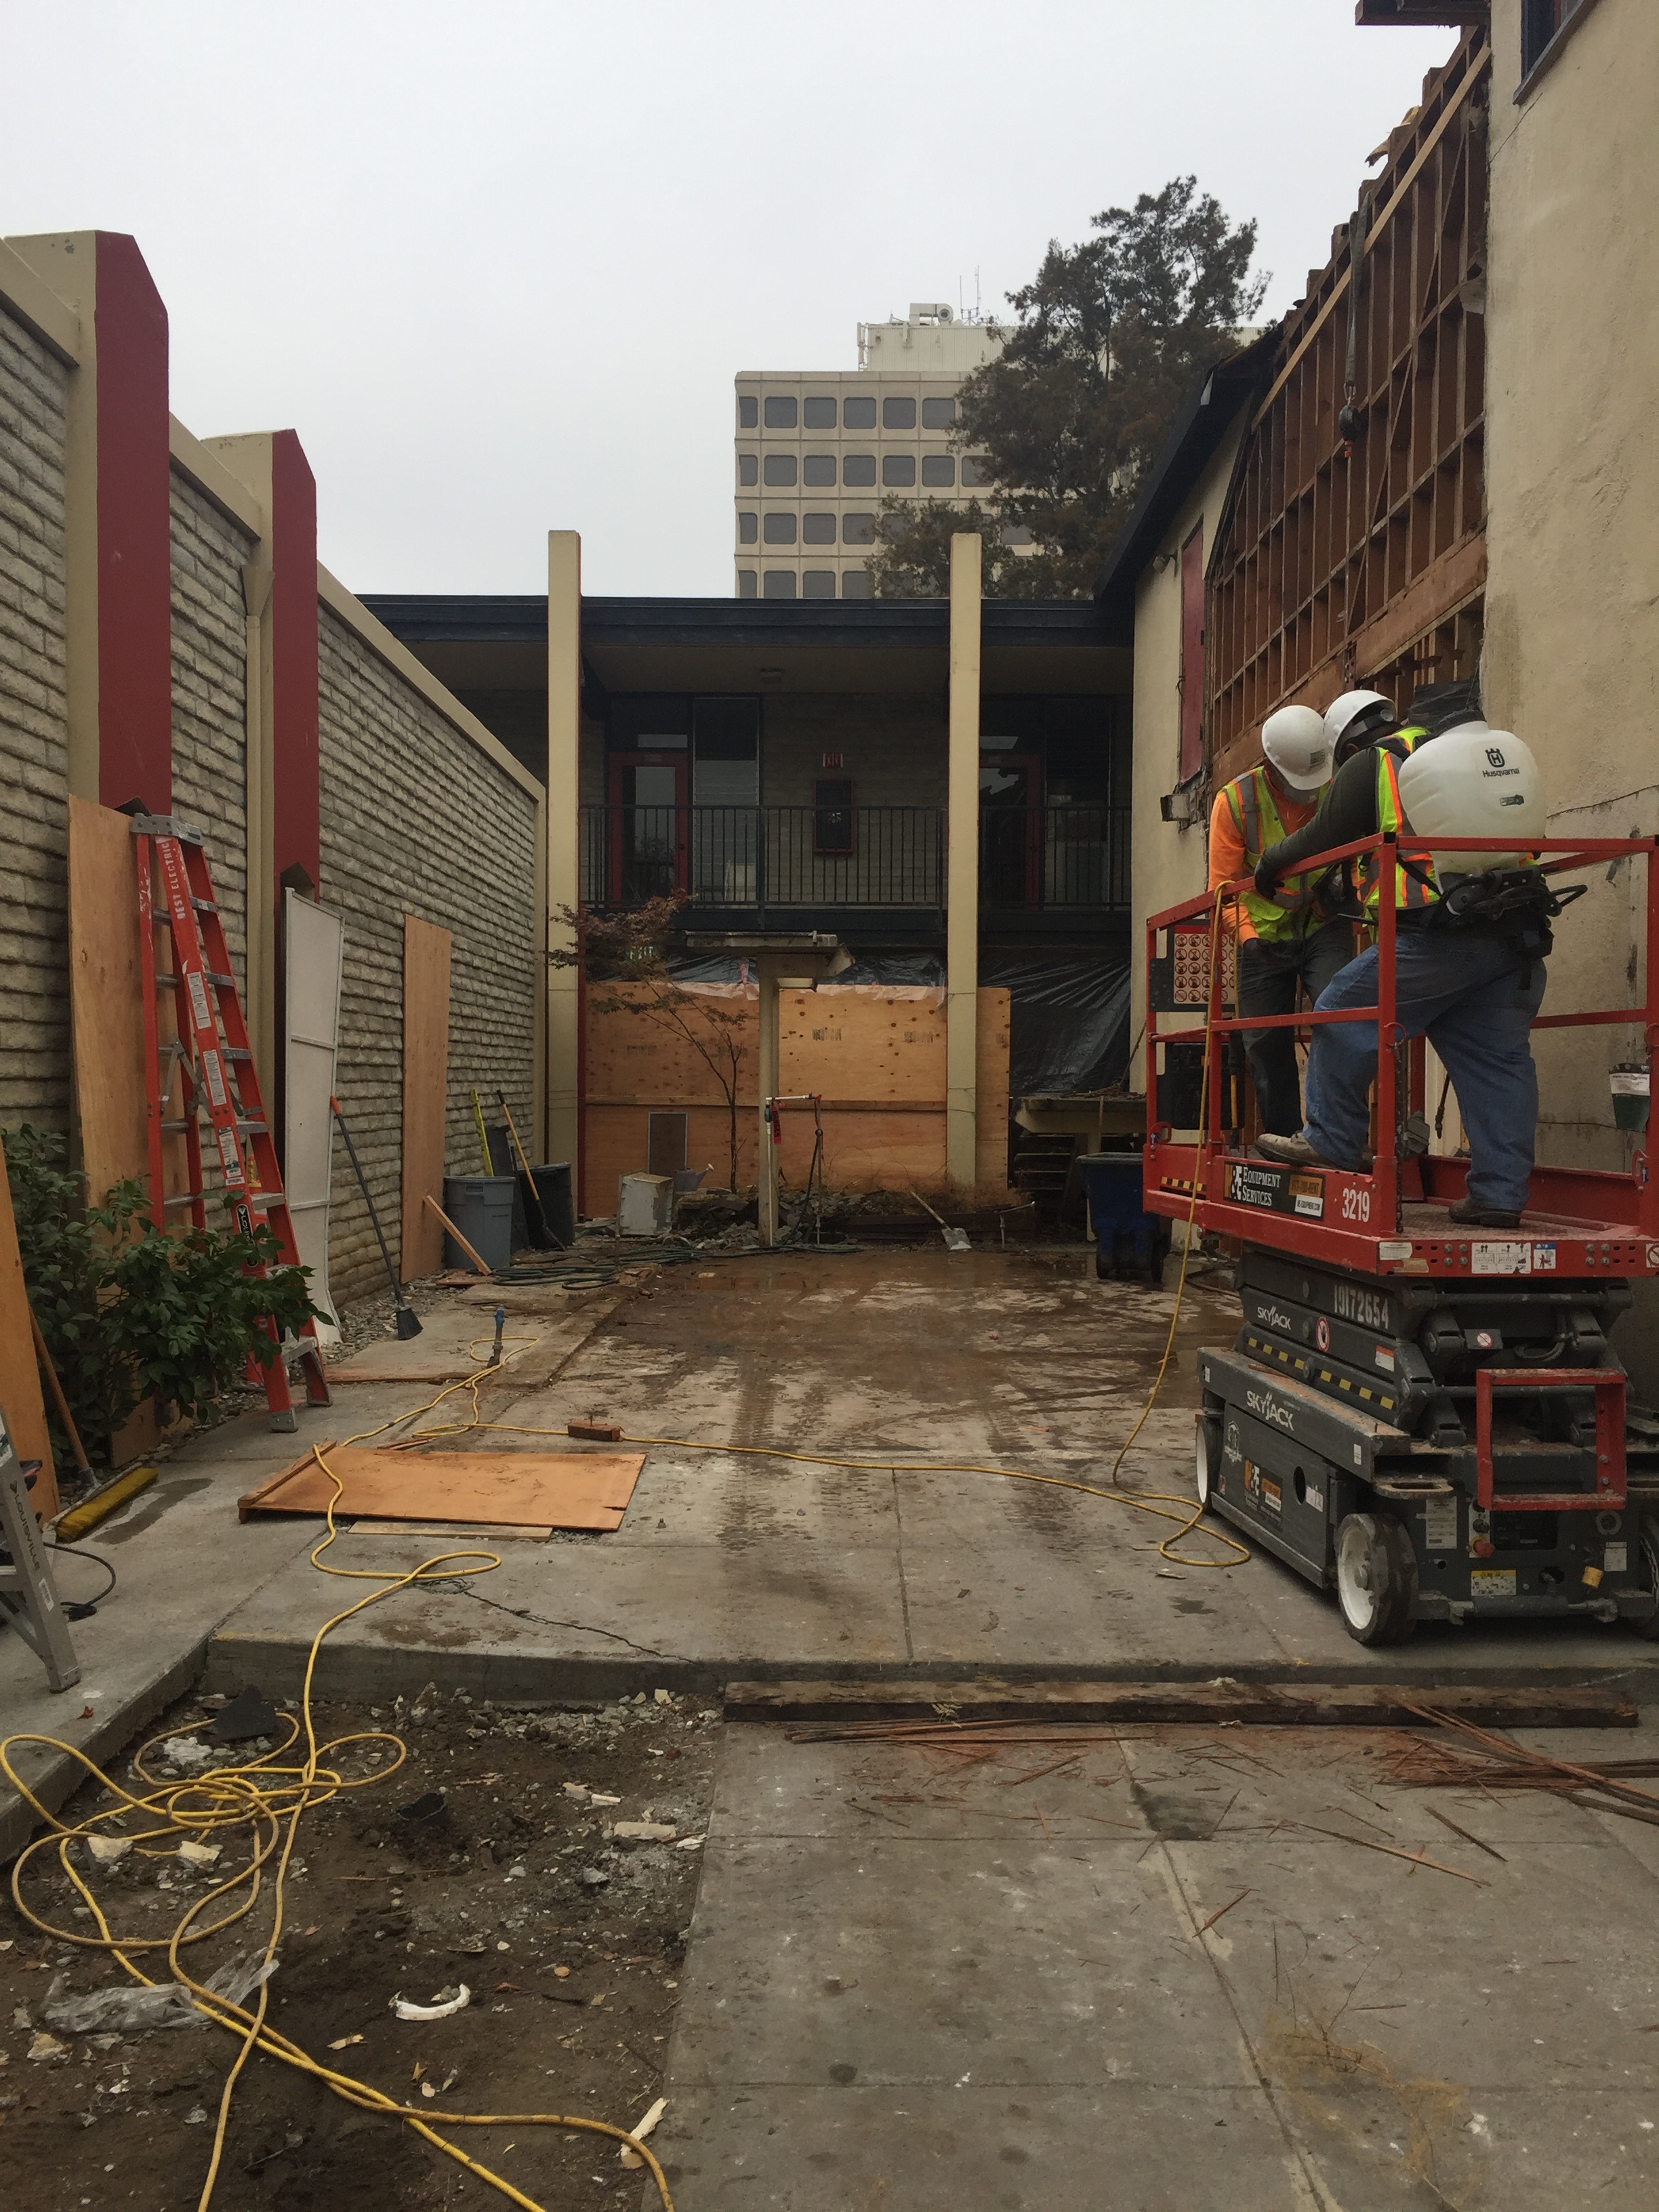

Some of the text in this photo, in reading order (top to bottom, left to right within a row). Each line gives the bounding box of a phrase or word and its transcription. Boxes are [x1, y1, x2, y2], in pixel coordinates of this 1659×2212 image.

[1482, 767, 1520, 778] Husqvarna
[161, 842, 186, 920] BEST ELECTRIC
[1243, 1166, 1282, 1188] EQUIPMENT
[1242, 1185, 1273, 1207] SERVICES
[1341, 1187, 1370, 1223] 3219
[1256, 1305, 1292, 1331] SKYJACK
[1246, 1390, 1295, 1432] SKYJACK
[14, 1494, 41, 1572] LOUISVILLE
